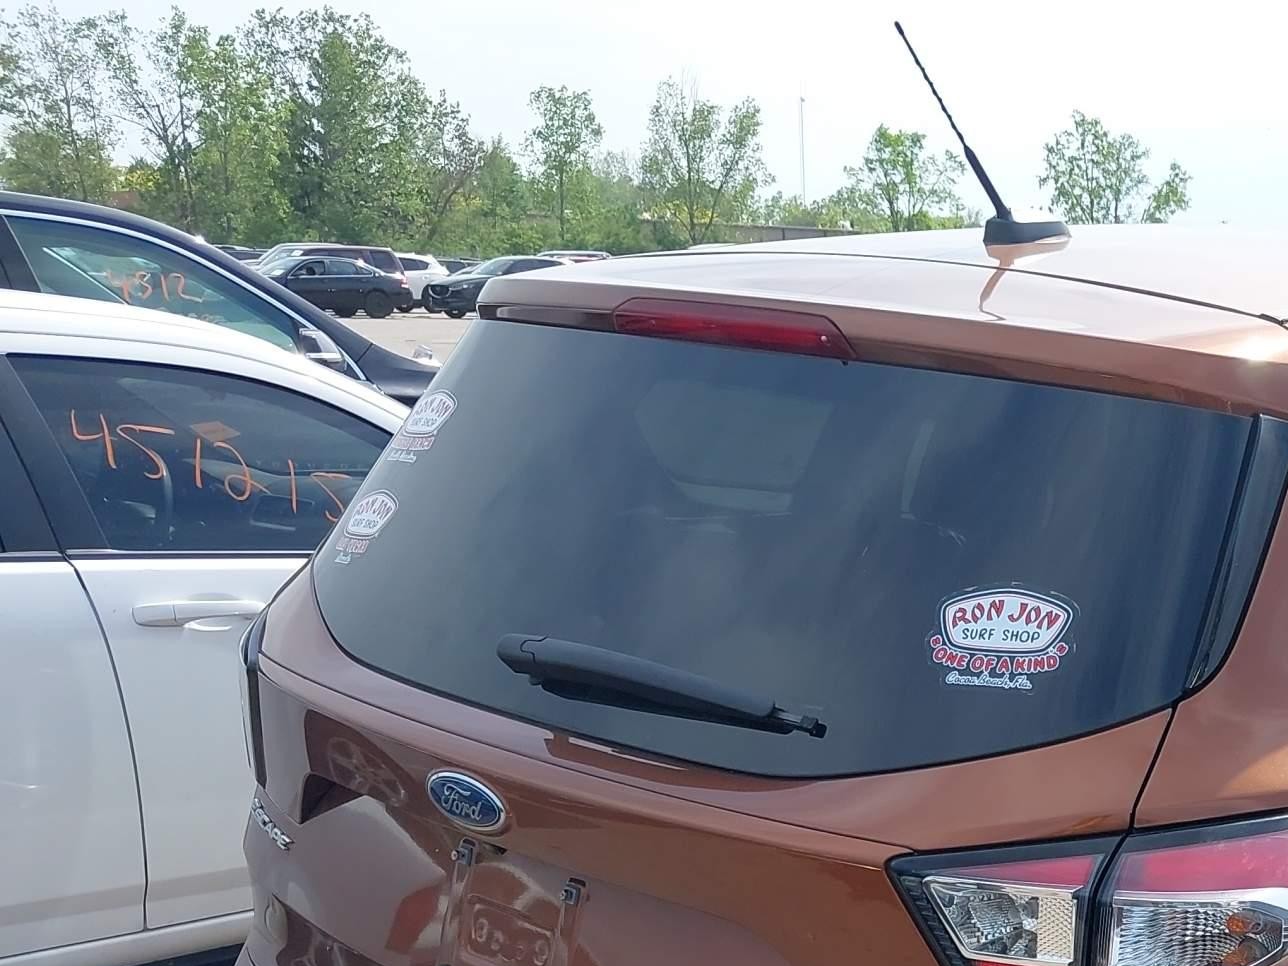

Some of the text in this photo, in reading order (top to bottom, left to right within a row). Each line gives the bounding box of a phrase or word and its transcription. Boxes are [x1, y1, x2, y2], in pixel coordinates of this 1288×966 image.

[951, 599, 1062, 631] RON JON
[961, 627, 1041, 643] SURF SHOP
[970, 654, 997, 672] OF
[996, 656, 1011, 673] A
[945, 671, 979, 687] Cocoa
[441, 783, 483, 821] Ford
